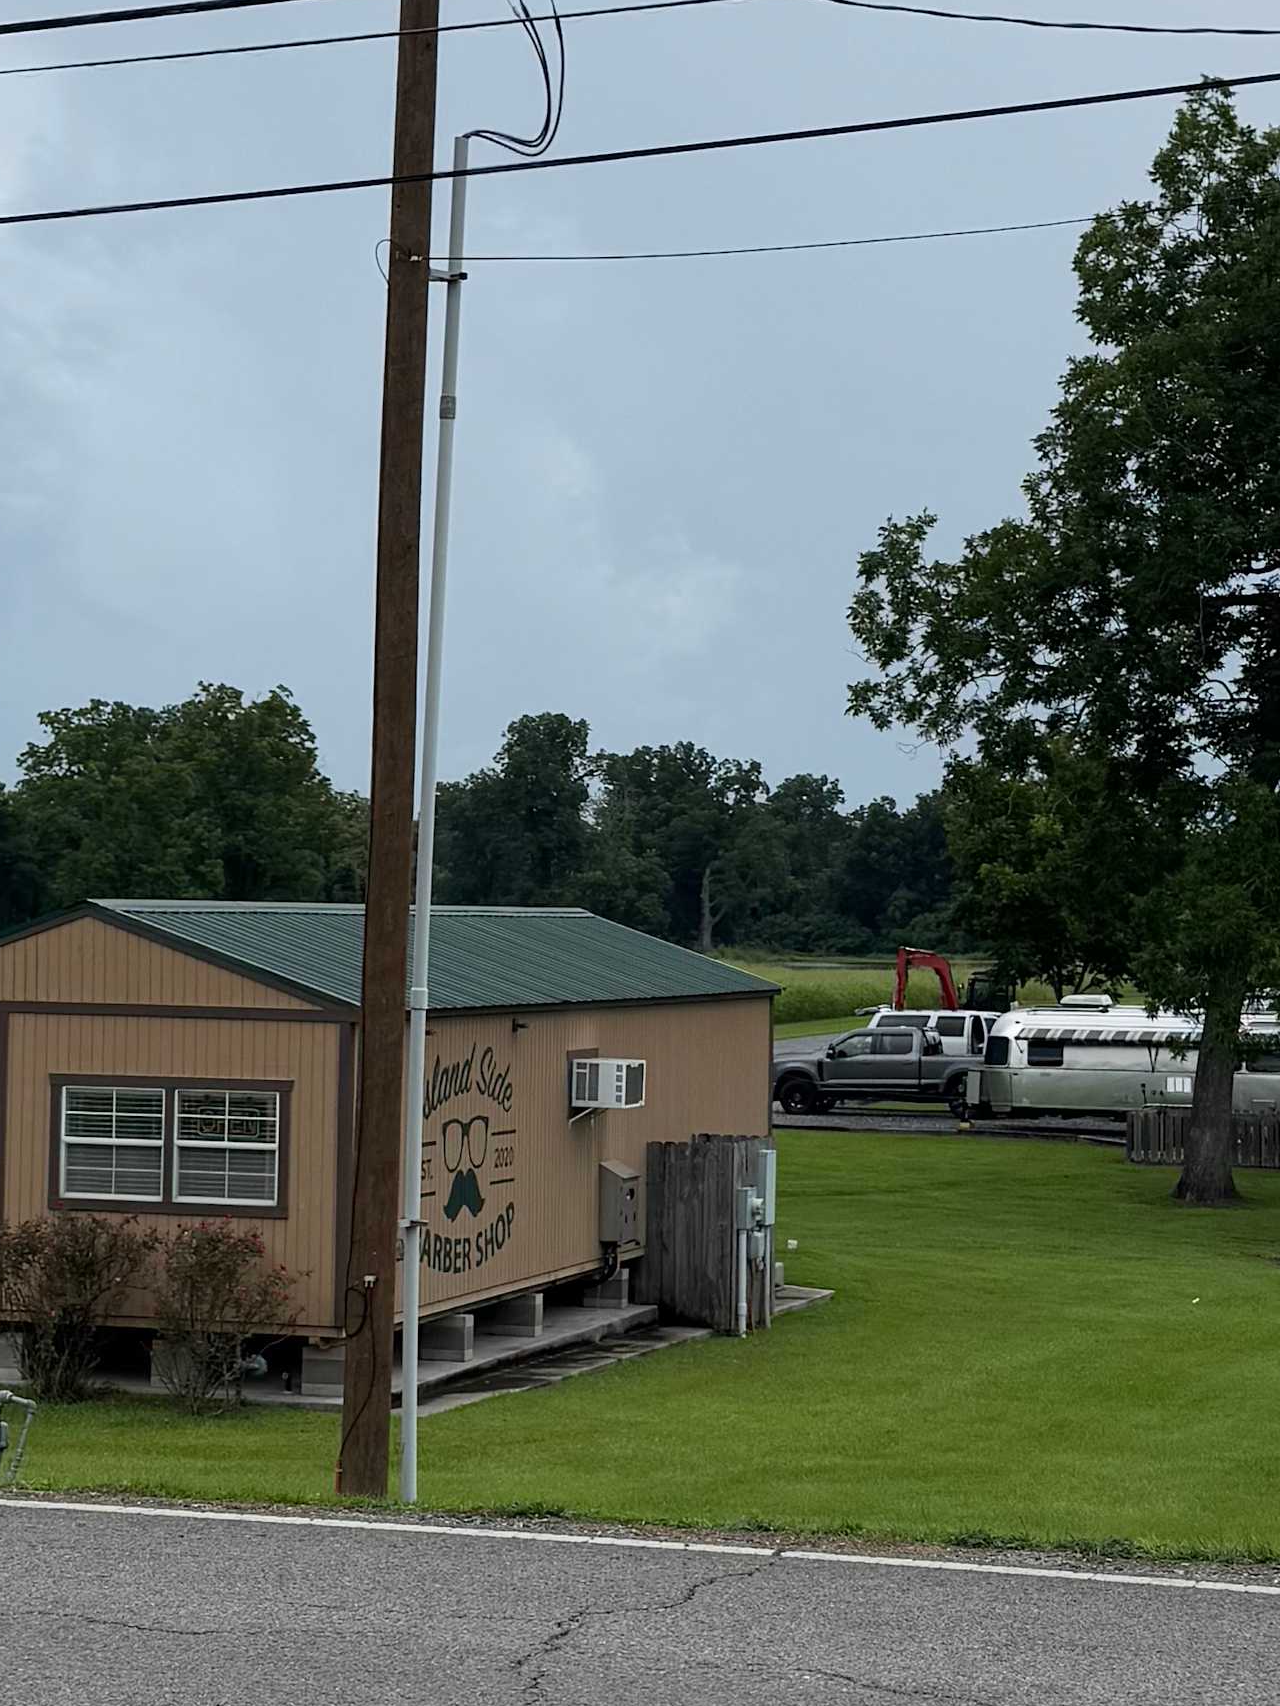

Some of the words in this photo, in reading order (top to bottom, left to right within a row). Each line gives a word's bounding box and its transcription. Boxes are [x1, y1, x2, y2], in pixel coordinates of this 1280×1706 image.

[422, 1042, 476, 1120] sland
[476, 1046, 514, 1114] Side
[493, 1146, 514, 1170] 2020
[419, 1227, 471, 1275] ARBER
[475, 1201, 515, 1268] SHOP
